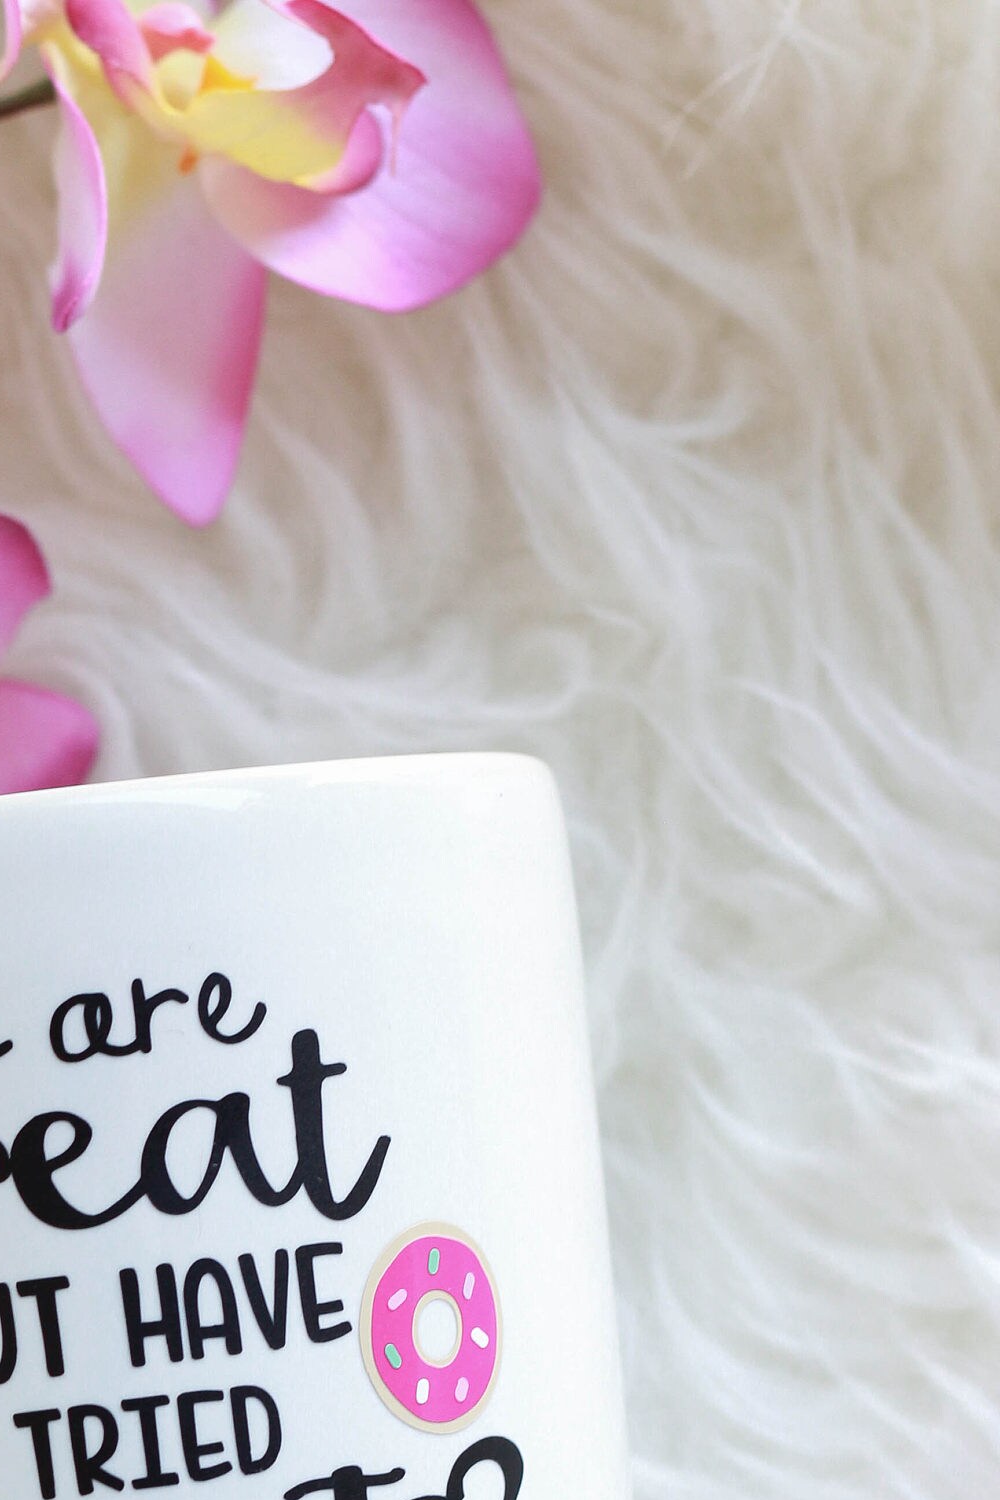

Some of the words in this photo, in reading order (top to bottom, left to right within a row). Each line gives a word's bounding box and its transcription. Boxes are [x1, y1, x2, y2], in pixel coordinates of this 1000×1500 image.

[49, 972, 267, 1064] are
[118, 1242, 353, 1368] HAVE
[12, 1385, 282, 1500] TRIED
